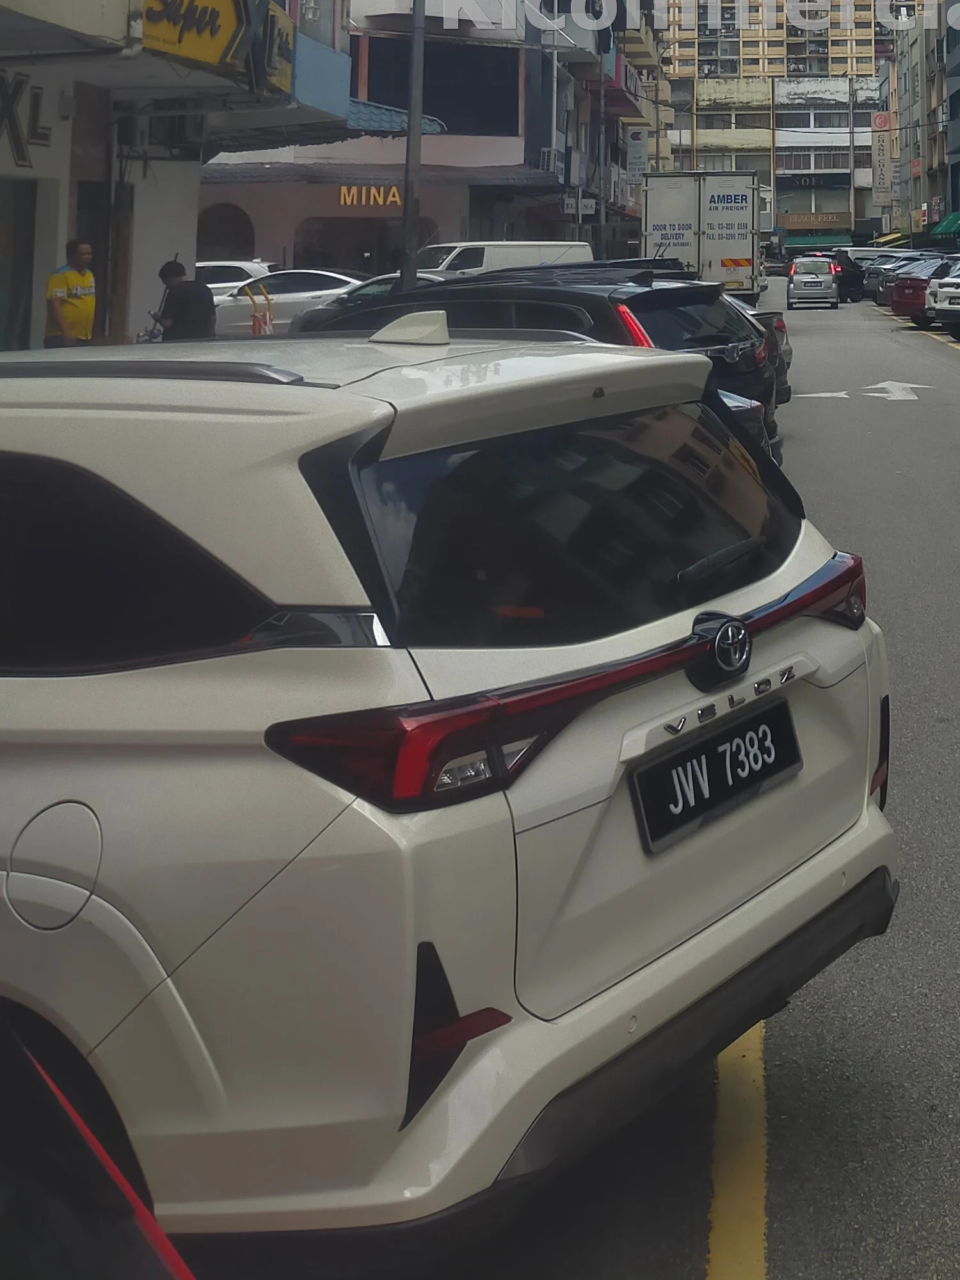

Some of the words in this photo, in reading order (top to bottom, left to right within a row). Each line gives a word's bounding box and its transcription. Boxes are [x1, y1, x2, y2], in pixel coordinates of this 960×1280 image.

[340, 185, 402, 206] MINA
[709, 194, 748, 204] AMBER
[664, 666, 796, 735] VELOZ
[717, 724, 776, 787] 7383
